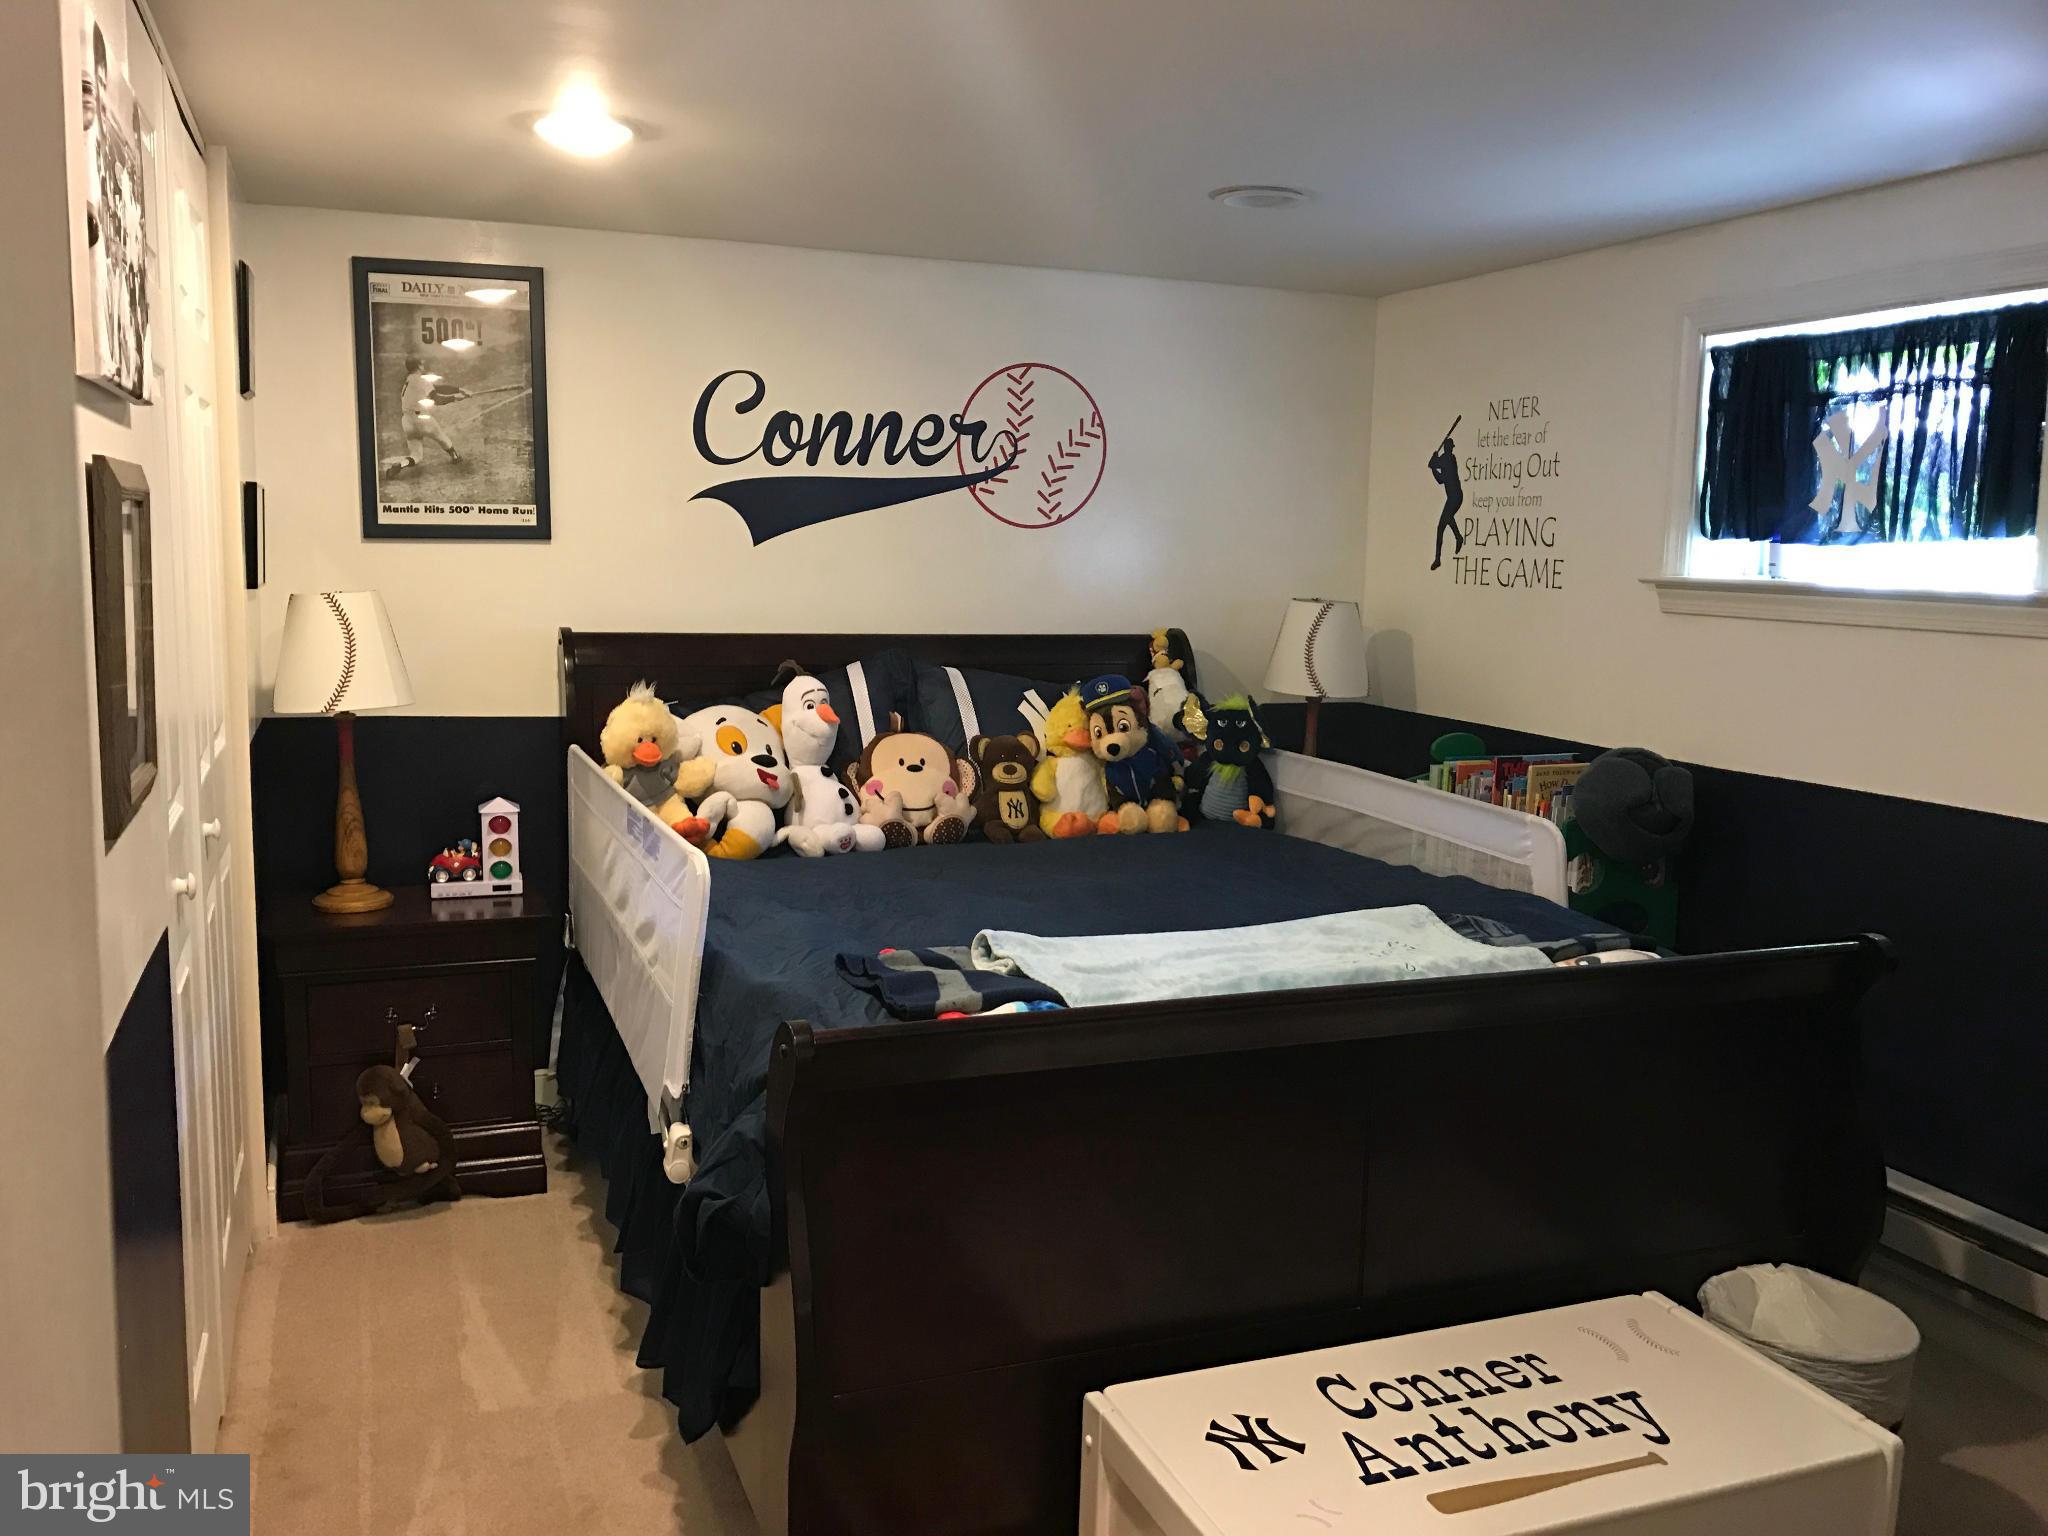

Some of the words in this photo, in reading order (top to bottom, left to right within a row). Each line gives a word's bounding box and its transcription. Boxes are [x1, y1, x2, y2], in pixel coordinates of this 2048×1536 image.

[372, 285, 389, 294] FINAL
[401, 281, 444, 294] DAILY
[692, 369, 1018, 467] Conner
[1488, 396, 1541, 422] NEVER
[1477, 428, 1490, 448] let
[1492, 426, 1509, 447] the
[1512, 424, 1532, 446] fear
[1534, 421, 1550, 444] of
[1463, 453, 1522, 489] Striking
[1526, 451, 1561, 479] Out
[382, 504, 420, 514] Mantle
[424, 504, 445, 514] Hits
[478, 506, 509, 515] Home
[512, 506, 536, 516] Run!
[1472, 492, 1494, 512] keep
[1496, 498, 1515, 512] you
[1517, 487, 1543, 508] from
[1463, 516, 1557, 548] PLAYING
[1452, 555, 1492, 586] THE
[1496, 557, 1565, 590] GAME
[1006, 797, 1025, 819] NY
[1315, 1352, 1564, 1420] Conner
[1341, 1390, 1671, 1487] Anthony
